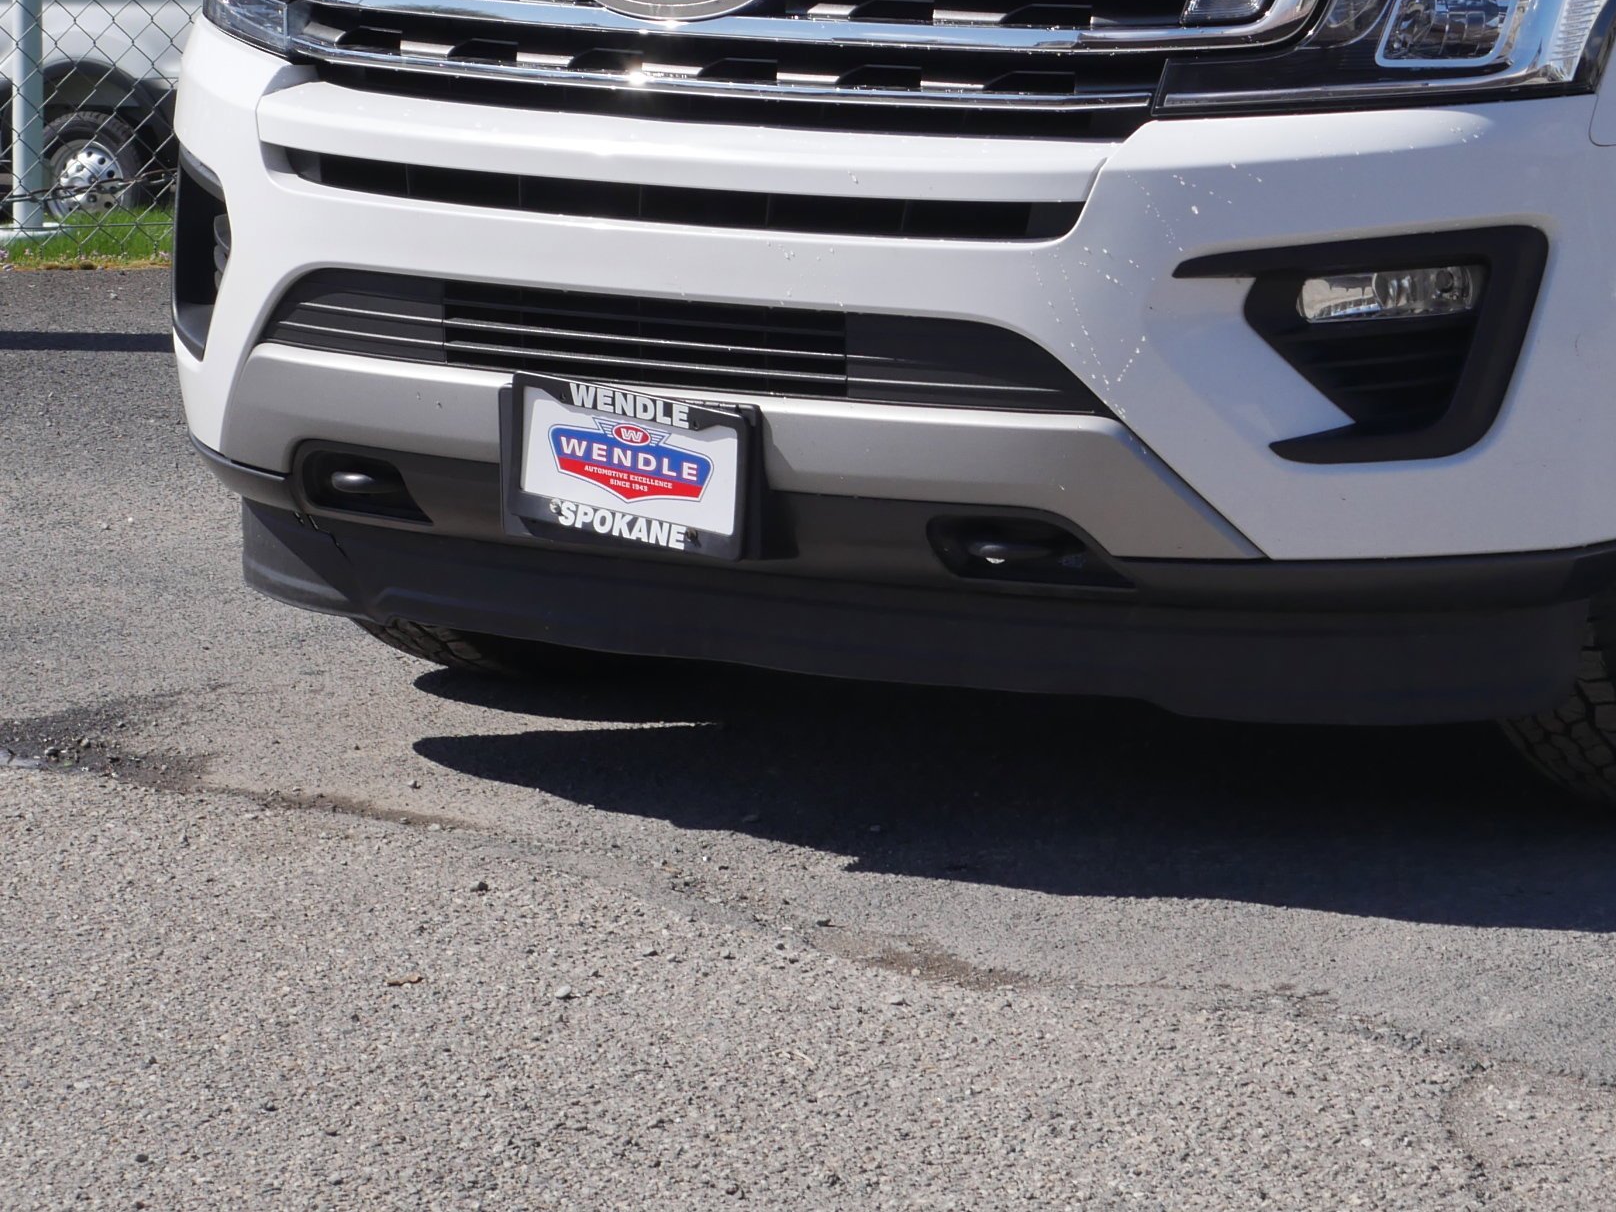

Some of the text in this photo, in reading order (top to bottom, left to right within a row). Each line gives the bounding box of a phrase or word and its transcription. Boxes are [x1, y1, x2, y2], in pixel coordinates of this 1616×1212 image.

[569, 382, 690, 429] WENDLE
[560, 436, 698, 481] WENDLE
[584, 465, 673, 489] AUTOMOTIVE EXCELLENCE
[609, 478, 649, 492] SINCE 1943
[558, 500, 687, 551] SPOKANE
